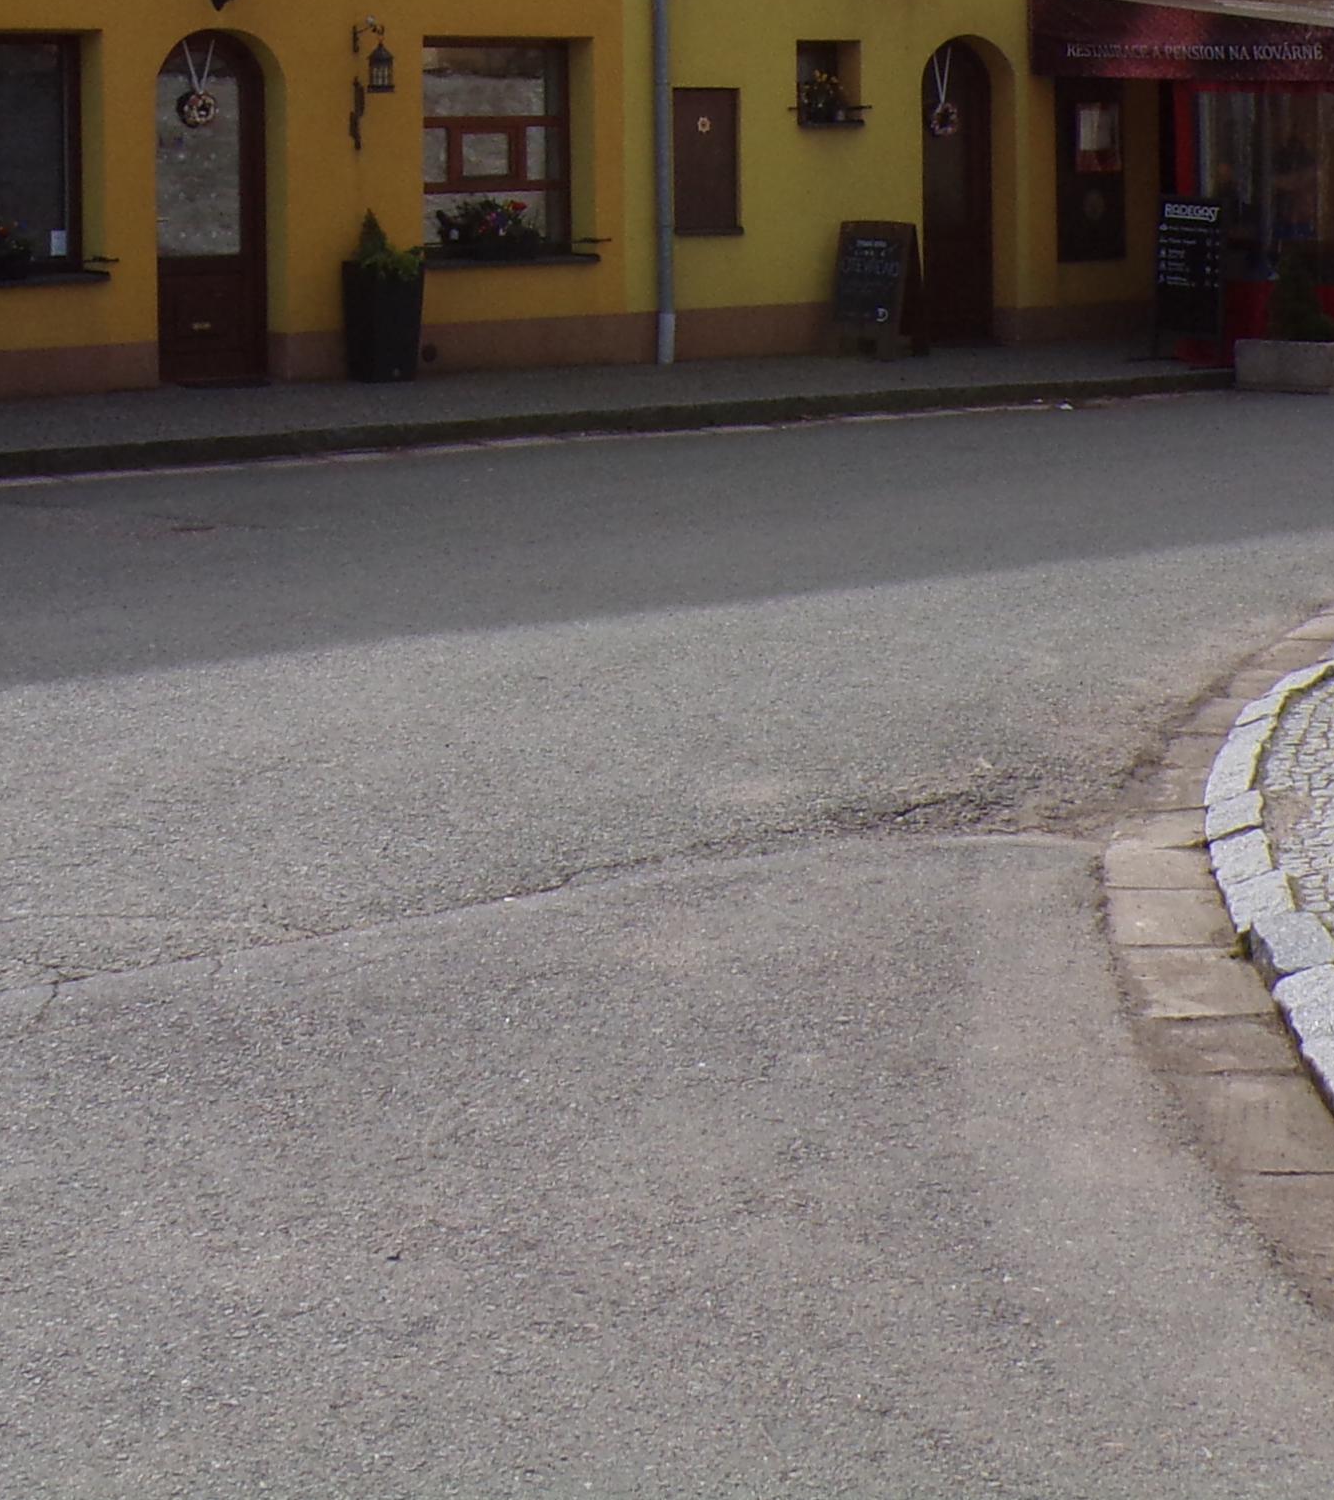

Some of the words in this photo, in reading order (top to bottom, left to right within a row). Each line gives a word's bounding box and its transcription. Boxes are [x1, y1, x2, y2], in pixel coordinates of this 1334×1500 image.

[1066, 43, 1149, 60] RESTAURACE
[1152, 45, 1164, 61] A
[1165, 43, 1226, 61] PENSION
[1227, 44, 1251, 61] NA
[1253, 42, 1324, 61] KOVÁRNĚ
